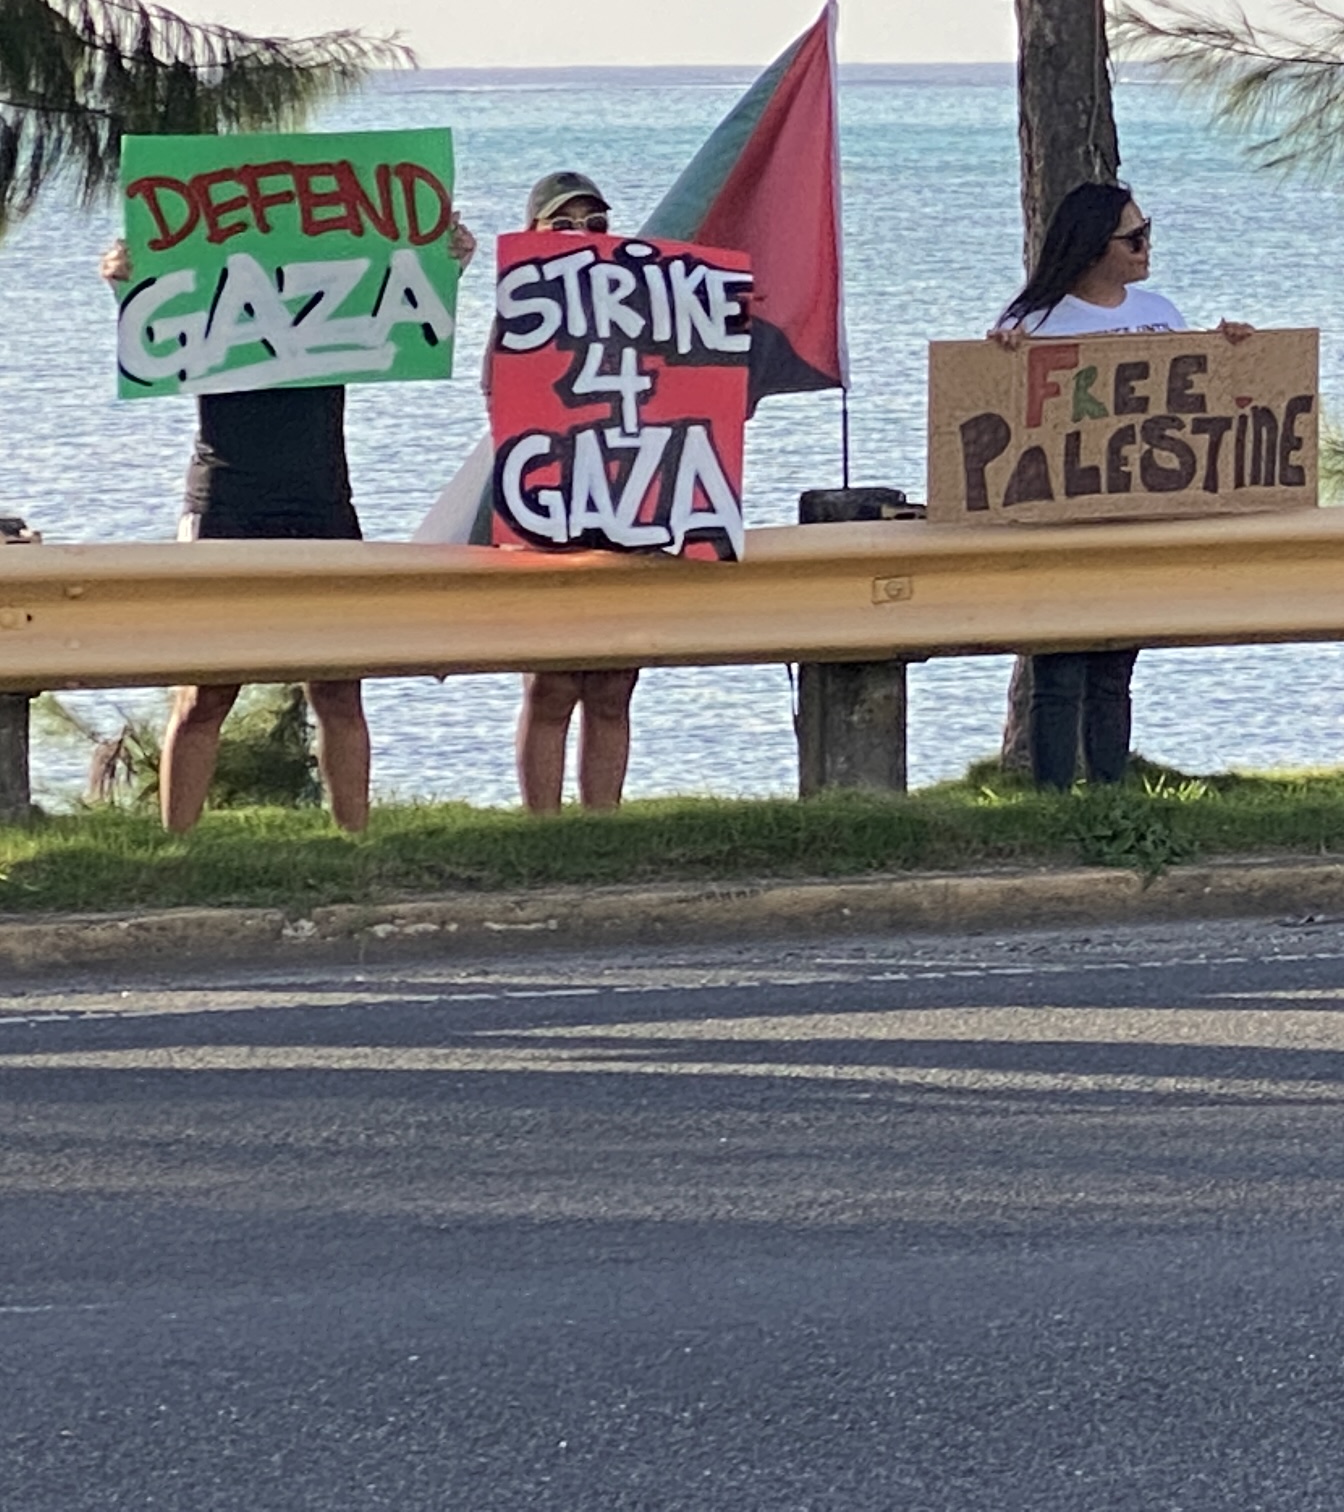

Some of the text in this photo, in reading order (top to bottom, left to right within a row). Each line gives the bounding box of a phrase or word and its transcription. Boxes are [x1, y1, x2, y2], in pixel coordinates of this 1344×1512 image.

[128, 160, 451, 251] DEFEND
[118, 250, 453, 386] GAZA
[499, 244, 753, 355] STRIKE
[573, 344, 652, 434] 4
[1027, 343, 1209, 429] FREE
[499, 424, 746, 562] GAZA
[960, 394, 1315, 512] PALESTINE
